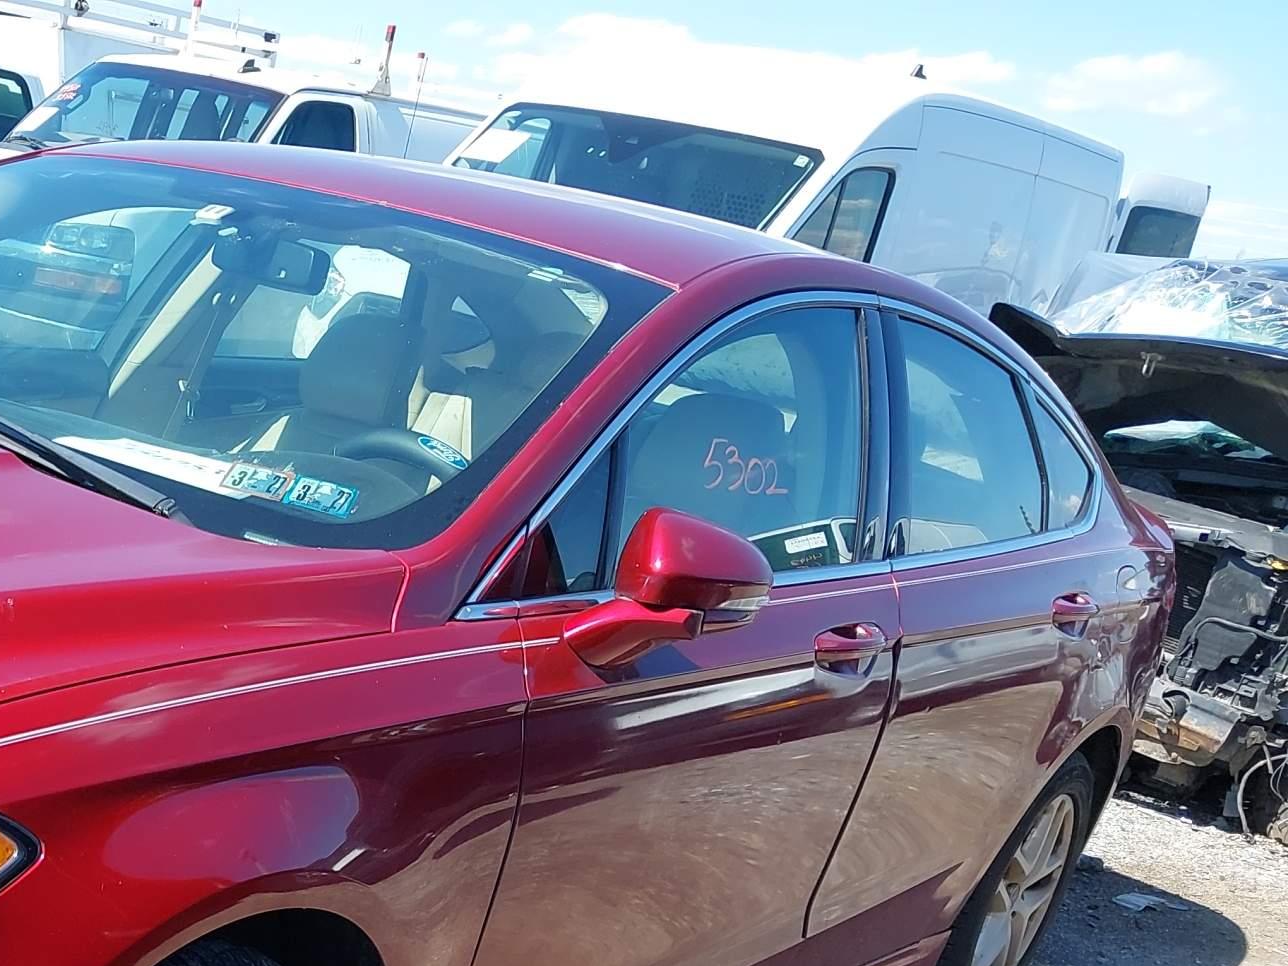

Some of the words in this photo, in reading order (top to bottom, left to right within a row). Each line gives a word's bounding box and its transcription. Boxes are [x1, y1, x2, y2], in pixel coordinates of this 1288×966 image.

[704, 438, 788, 494] 5302
[265, 475, 288, 496] 27
[296, 484, 312, 501] 3
[329, 490, 352, 513] 27
